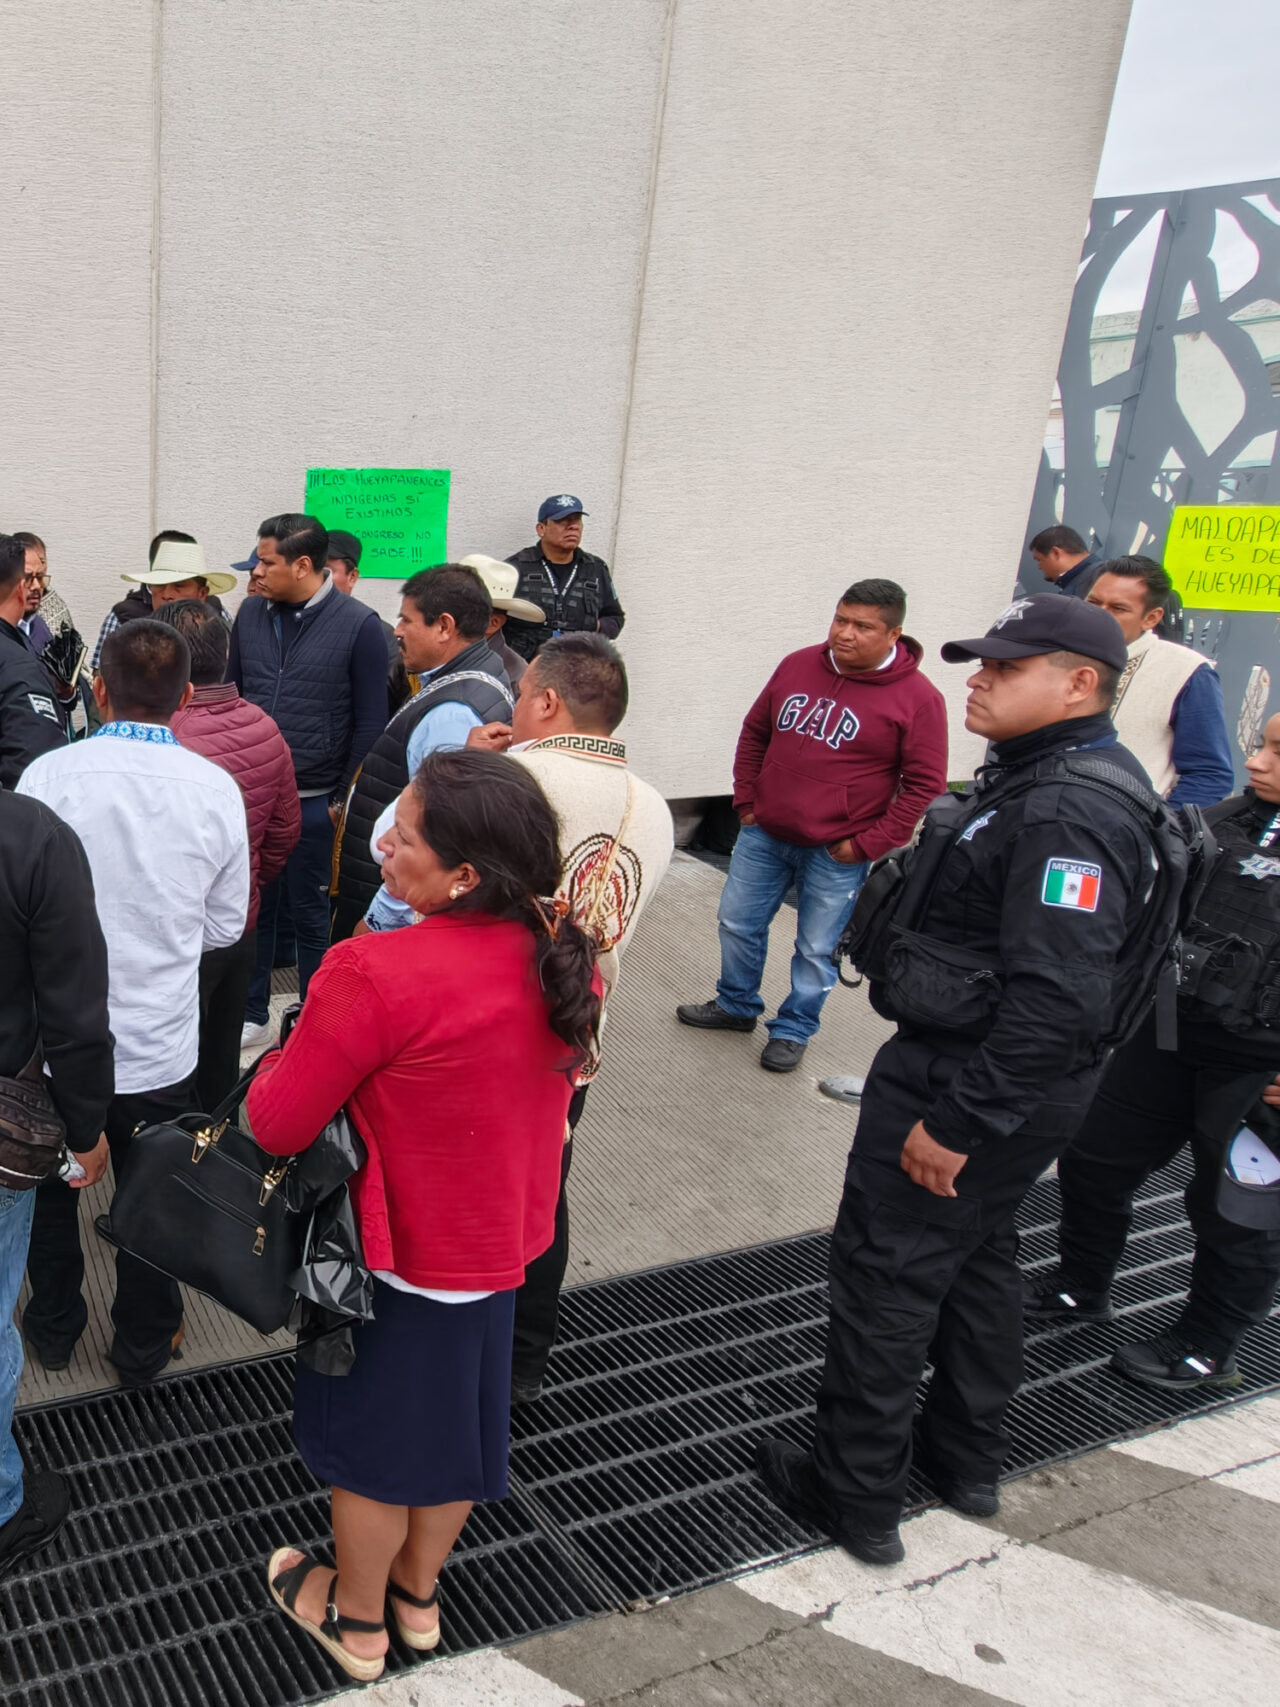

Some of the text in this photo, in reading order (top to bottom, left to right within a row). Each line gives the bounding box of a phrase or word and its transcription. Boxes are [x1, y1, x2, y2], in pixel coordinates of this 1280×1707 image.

[331, 494, 397, 505] INDIGENAS
[415, 530, 431, 540] NO
[1205, 546, 1235, 562] ES
[777, 693, 860, 750] GAP
